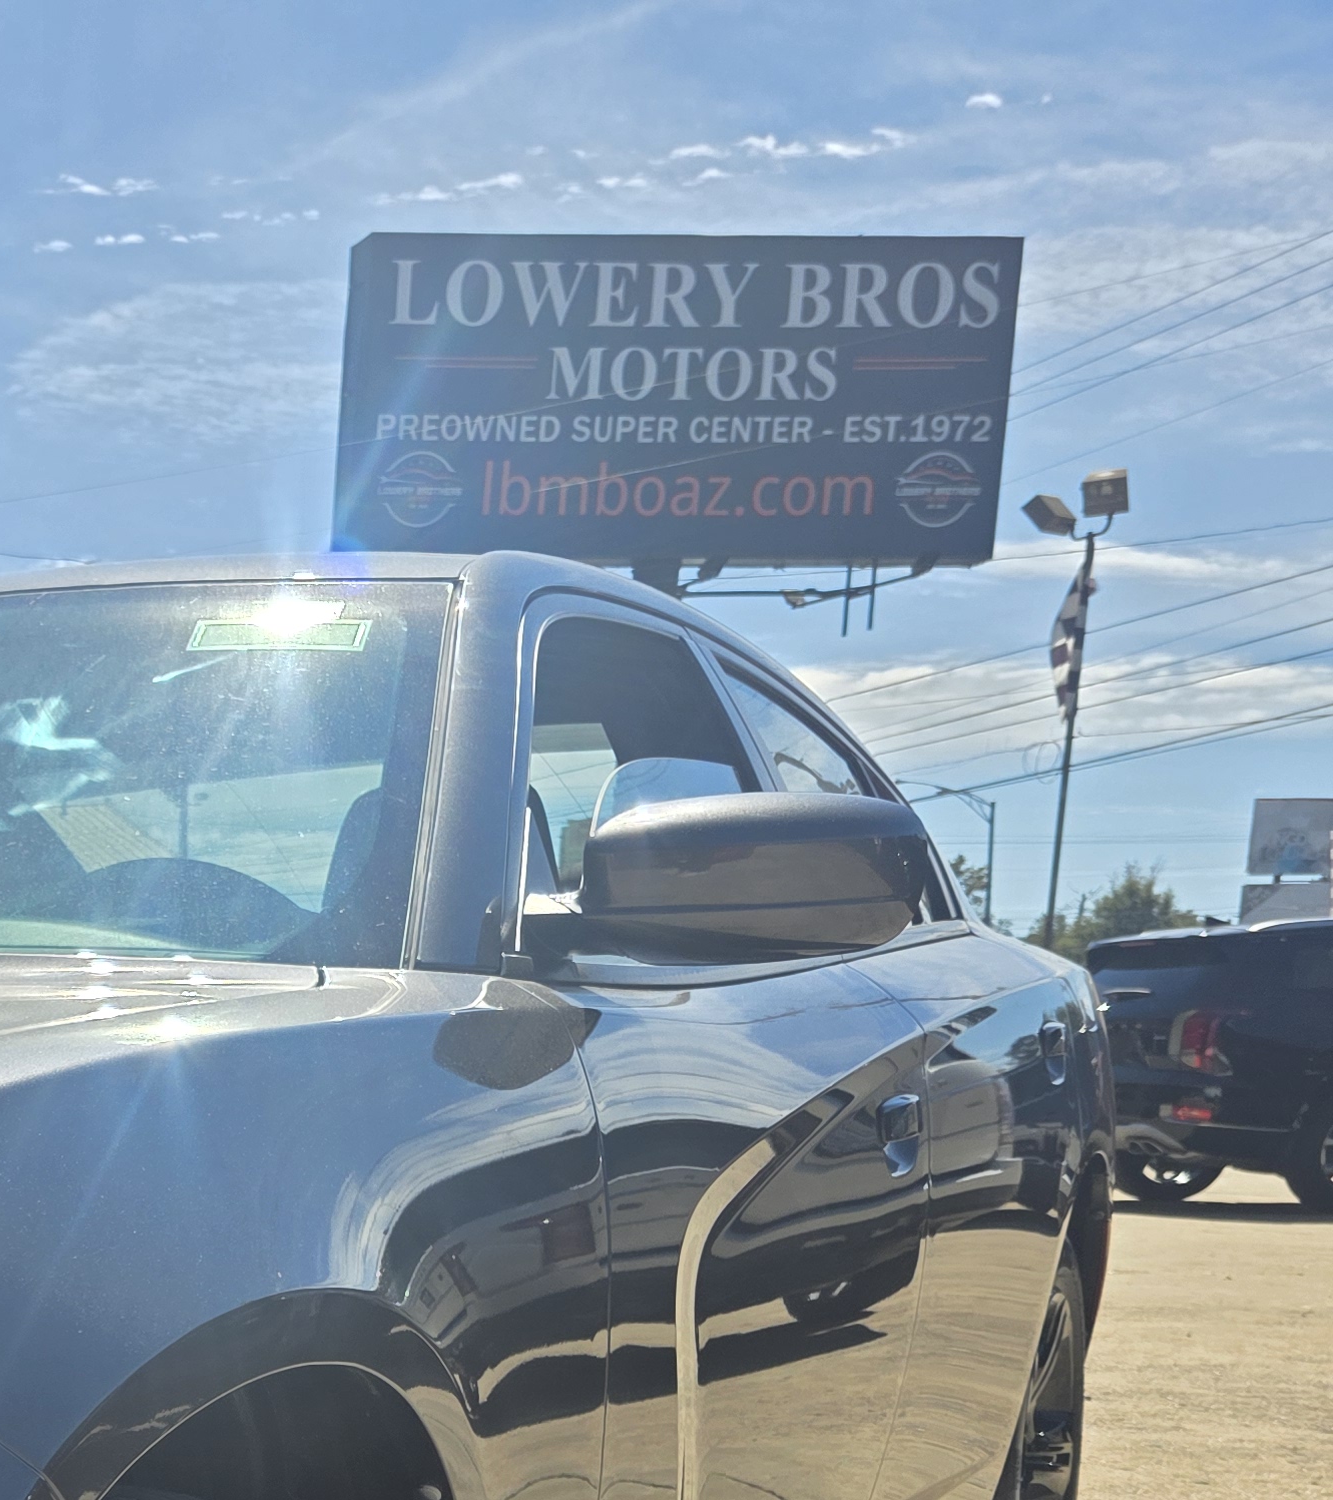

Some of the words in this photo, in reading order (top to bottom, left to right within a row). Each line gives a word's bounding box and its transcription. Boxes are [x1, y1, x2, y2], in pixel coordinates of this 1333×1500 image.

[389, 259, 758, 328] LOWERY
[779, 261, 1002, 329] BROS
[545, 346, 838, 401] MOTORS
[375, 413, 561, 443] PREOWNED
[570, 415, 679, 444] SUPER
[688, 415, 813, 444] CENTER
[480, 459, 876, 518] lbmboaz.com
